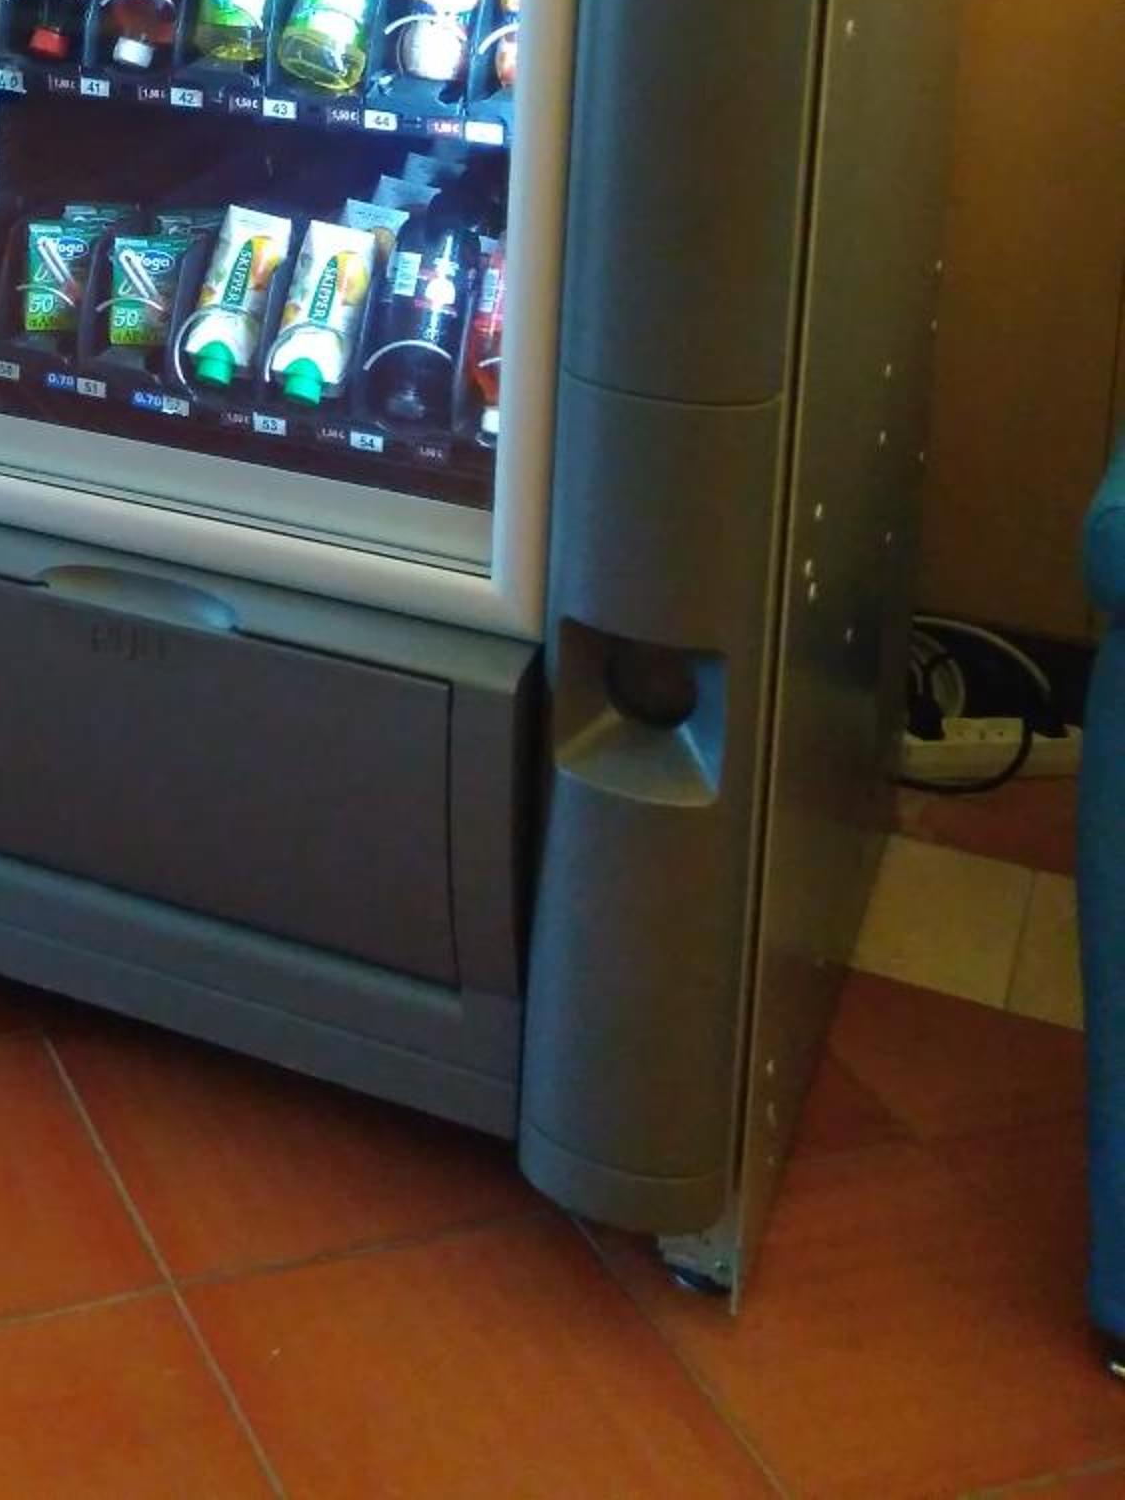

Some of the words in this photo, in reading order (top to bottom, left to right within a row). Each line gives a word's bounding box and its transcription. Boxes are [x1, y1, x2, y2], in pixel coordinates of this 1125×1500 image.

[86, 81, 100, 93] 41
[178, 91, 194, 104] 42
[272, 103, 288, 115] 43
[374, 116, 390, 127] 44
[53, 238, 84, 257] oga
[225, 248, 252, 302] SKIPPER
[29, 293, 54, 313] 50
[114, 305, 140, 327] 50
[48, 373, 74, 387] 0.70
[134, 392, 162, 406] 0.70
[360, 435, 376, 448] 54
